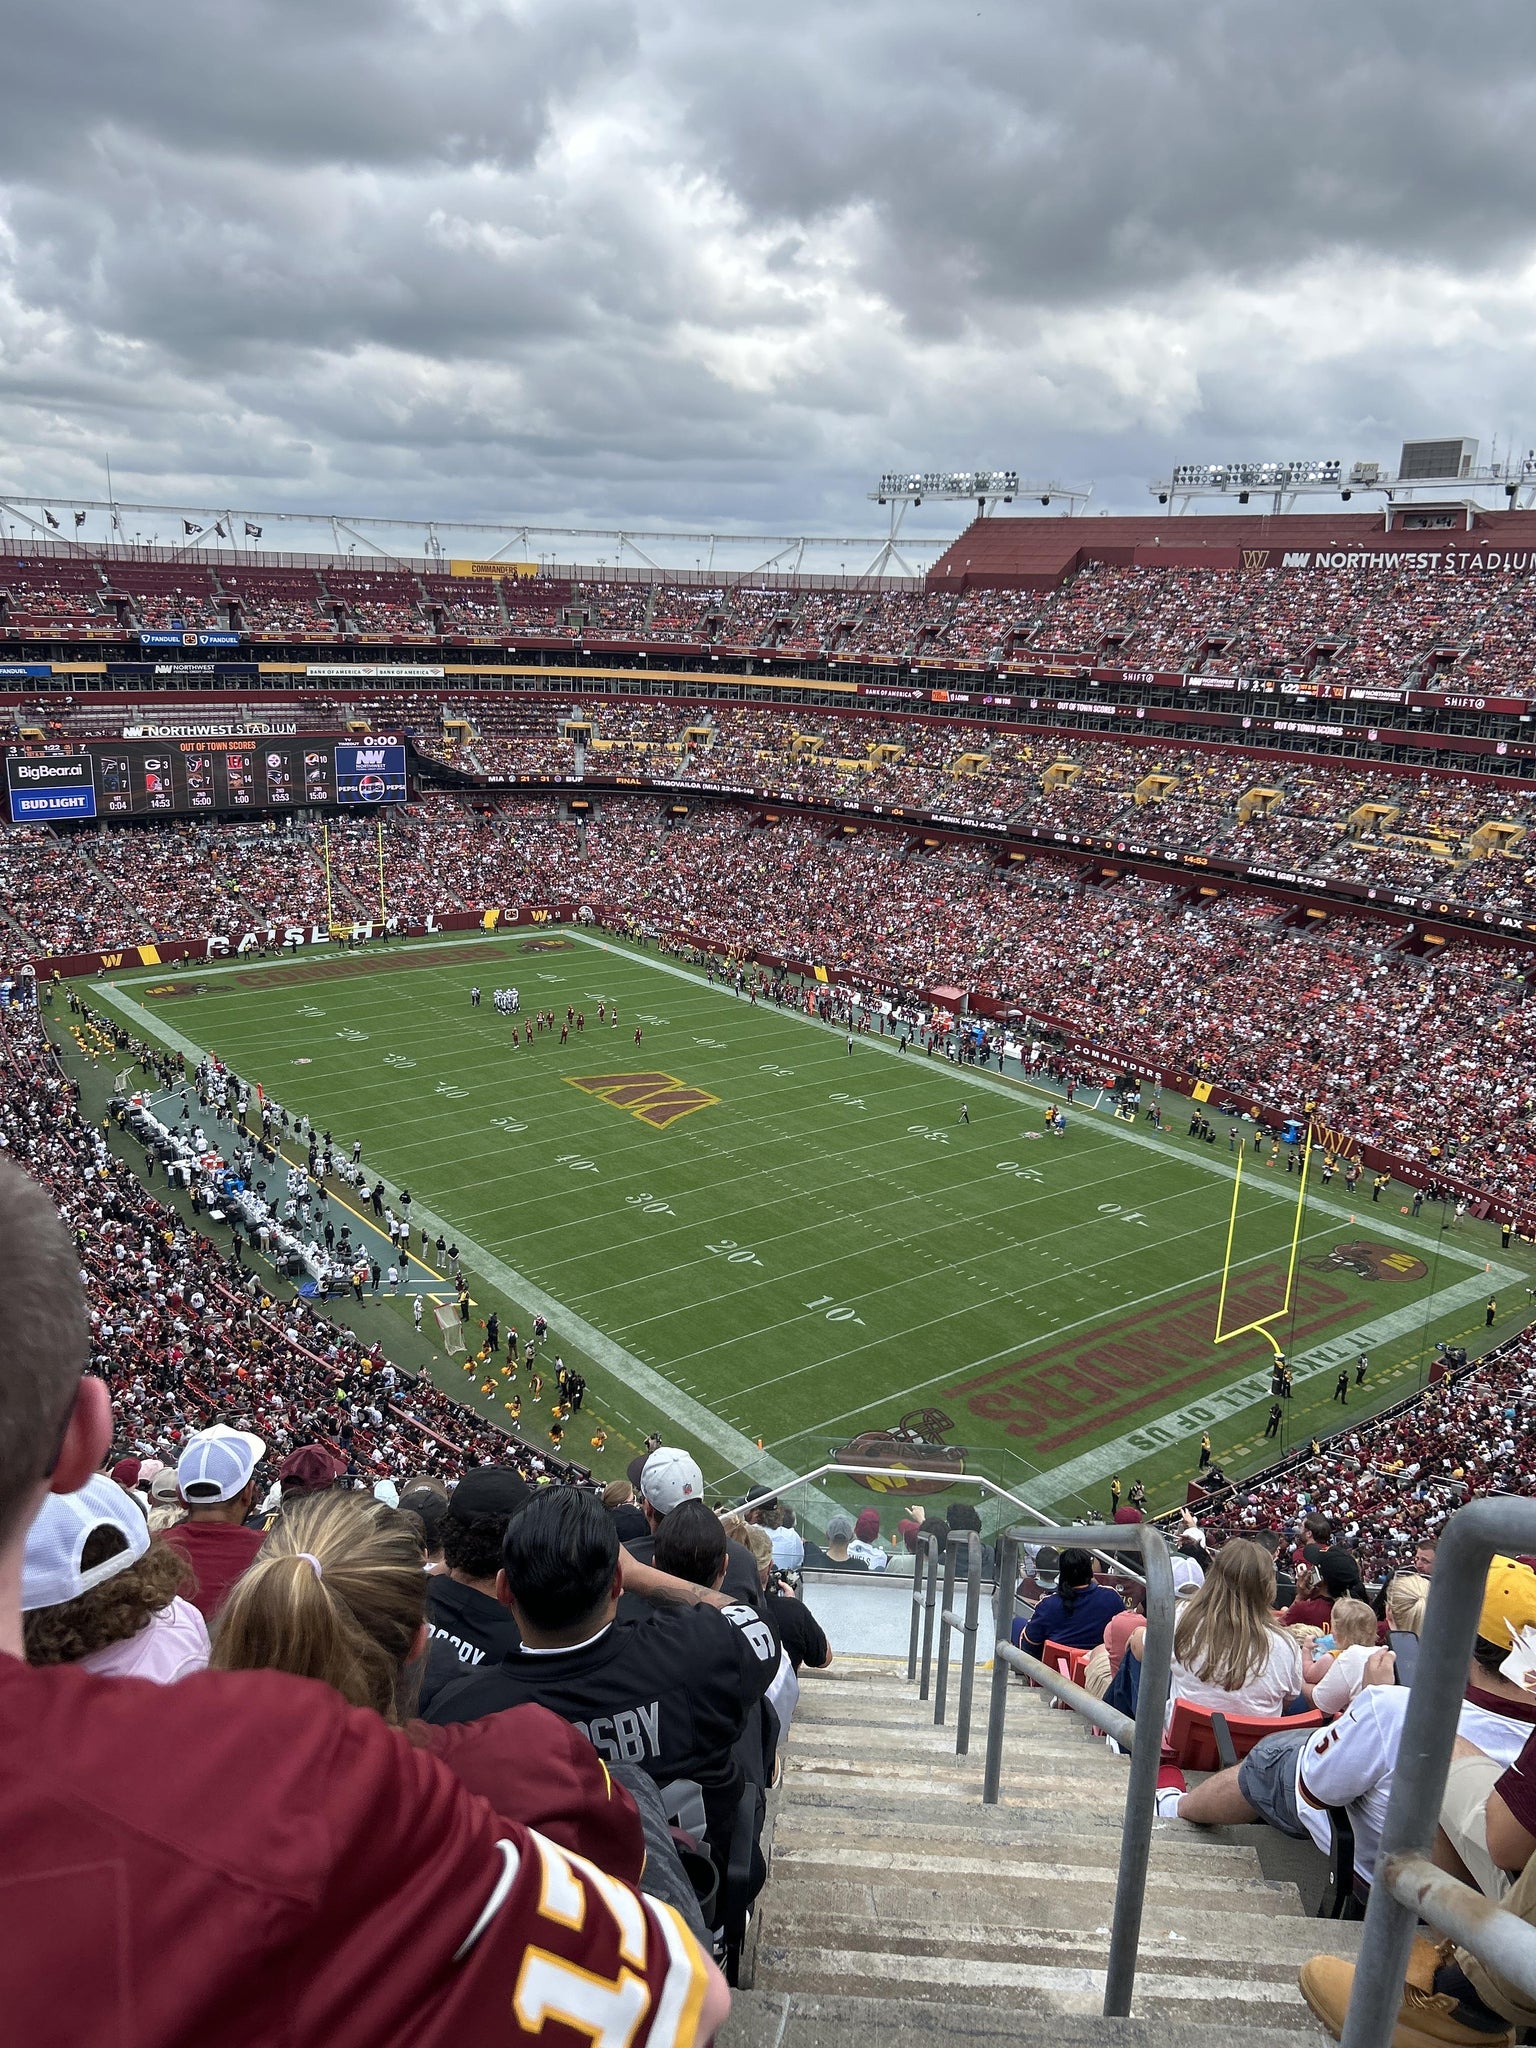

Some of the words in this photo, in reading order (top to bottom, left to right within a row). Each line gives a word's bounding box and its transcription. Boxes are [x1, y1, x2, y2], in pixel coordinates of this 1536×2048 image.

[1315, 552, 1441, 569] NORTHWEST
[471, 563, 518, 575] COMMANDERS
[155, 664, 172, 674] NW
[887, 690, 912, 698] AMERICA
[1057, 701, 1068, 710] OUT
[1076, 703, 1093, 713] TOWN
[1093, 704, 1116, 715] SCORES
[123, 727, 143, 737] NW
[148, 724, 234, 736] NORTHWEST
[236, 723, 297, 735] STADIUM
[1274, 721, 1287, 730] OUT
[1295, 723, 1316, 733] TOWN
[1316, 724, 1344, 736] SCORES
[180, 742, 195, 752] OUT
[196, 742, 206, 751] OF
[207, 741, 228, 751] TOWN
[228, 741, 256, 750] SCORES
[363, 735, 398, 746] 0:00
[319, 756, 328, 764] 10
[355, 750, 386, 764] NW
[18, 763, 83, 780] BigBear.ai
[243, 775, 252, 783] 14
[616, 777, 642, 785] FINAL
[702, 783, 721, 792] (MIA)
[21, 799, 48, 810] BUD
[49, 797, 86, 808] LIGHT
[150, 799, 171, 808] 14:53
[191, 797, 212, 806] 15:00
[234, 795, 250, 804] 1:00
[271, 793, 290, 802] 13:53
[309, 791, 328, 800] 15:00
[780, 792, 794, 801] ATL
[843, 801, 860, 810] CAR
[109, 801, 127, 810] 0:04
[873, 805, 883, 814] Q1
[931, 813, 961, 825] M.PENIX
[961, 817, 979, 829] (ATL)
[1054, 832, 1067, 841] GB
[1129, 844, 1148, 855] CLV
[1164, 851, 1178, 861] Q2
[1183, 854, 1208, 866] 14:53
[1247, 866, 1276, 878] J.LOVE
[1276, 871, 1296, 882] (GB)
[1394, 894, 1418, 906] HST
[1439, 904, 1449, 913] 0
[1499, 916, 1524, 929] JAX
[353, 914, 440, 941] HAL
[234, 946, 506, 988] COMMANDERS
[851, 975, 919, 1001] WASINGON
[296, 1004, 327, 1018] 10
[336, 1028, 369, 1042] 20
[383, 1053, 417, 1069] 30
[1074, 1043, 1162, 1081] COMMANDERS
[758, 1063, 795, 1078] 50
[434, 1083, 470, 1099] 40
[828, 1092, 867, 1107] 40
[489, 1115, 529, 1133] 50
[906, 1125, 947, 1141] 30
[553, 1153, 596, 1171] 40
[995, 1160, 1043, 1182] 20
[1399, 1165, 1424, 1179] 1937
[1461, 1190, 1481, 1203] 198
[624, 1191, 670, 1214] 30
[1096, 1202, 1146, 1223] 10
[703, 1238, 757, 1264] 20
[801, 1294, 856, 1322] 10
[1344, 1331, 1378, 1350] IT
[966, 1272, 1349, 1438] COMMANDERS
[1267, 1345, 1351, 1380] TAKE
[1214, 1378, 1269, 1408] ALL
[1176, 1405, 1217, 1431] OF
[1127, 1427, 1172, 1452] US
[572, 1700, 661, 1764] SBY
[511, 1825, 651, 2048] 17
